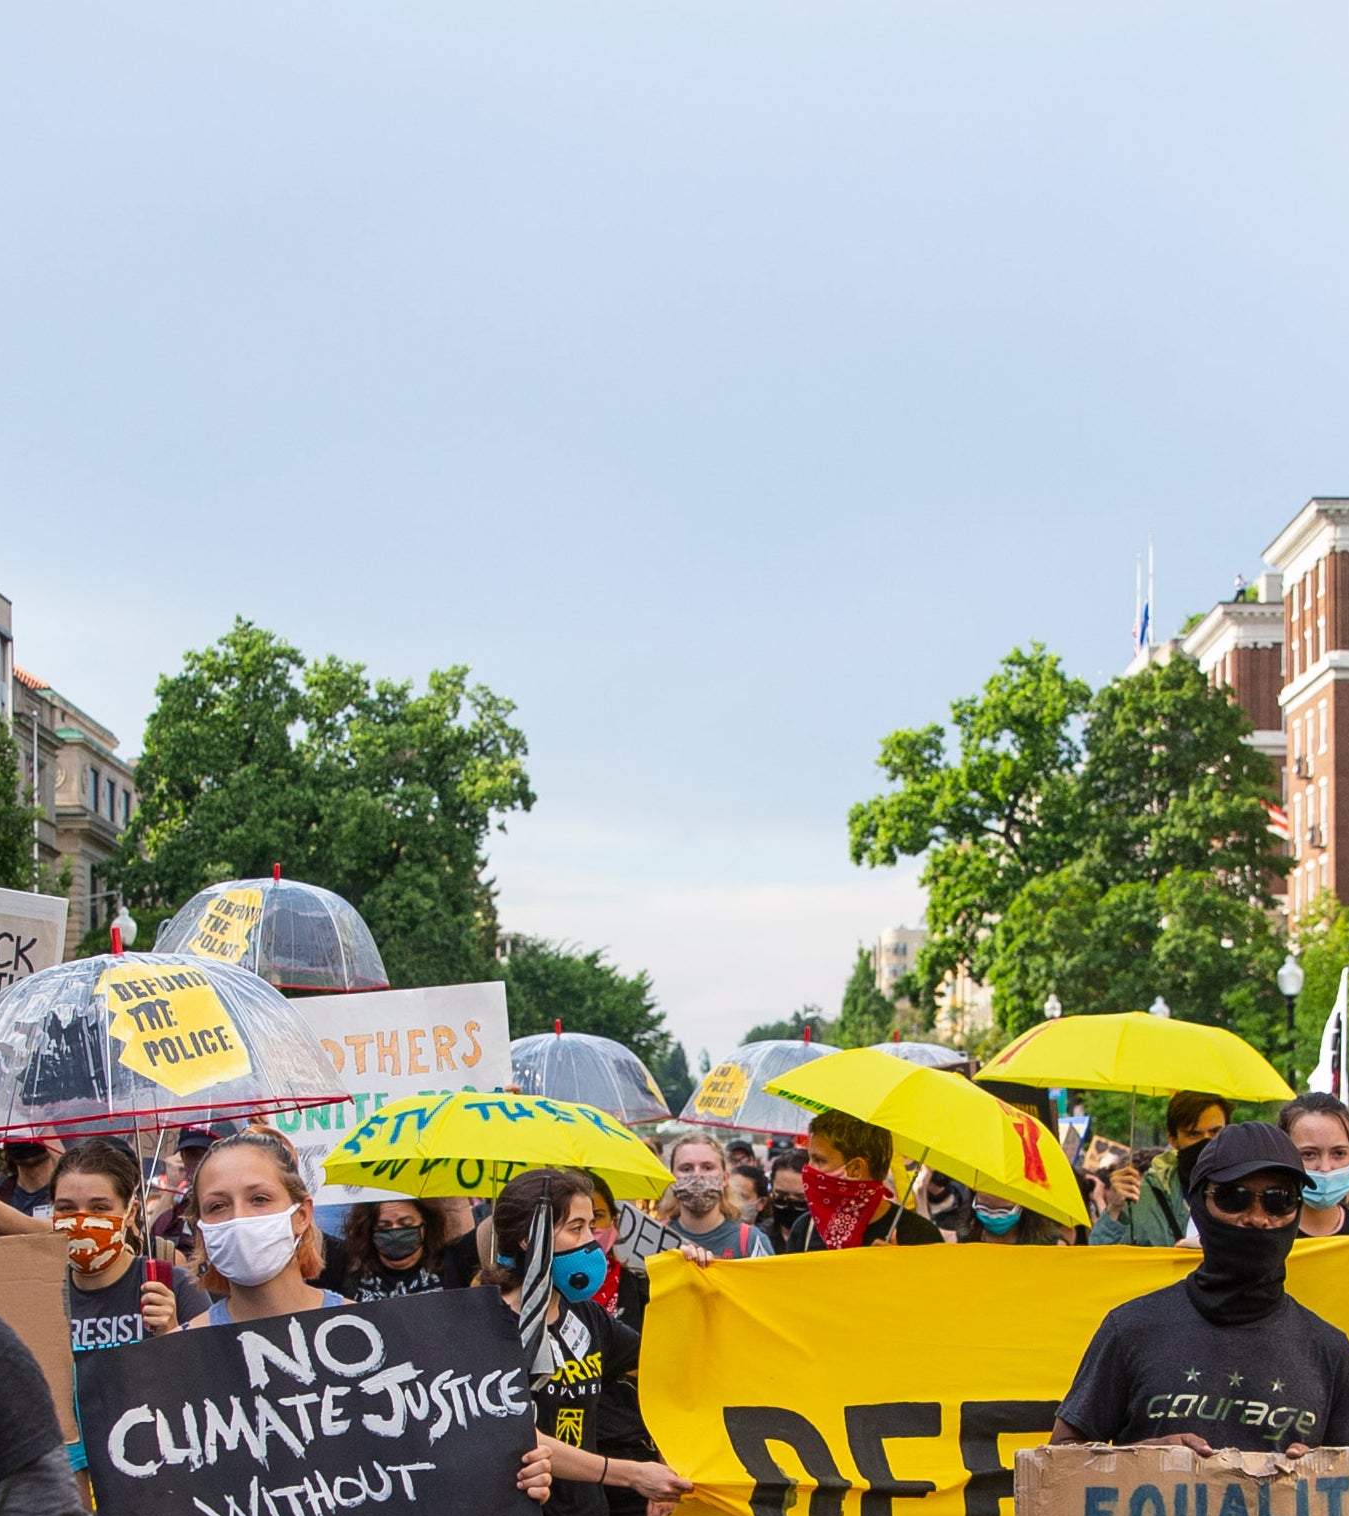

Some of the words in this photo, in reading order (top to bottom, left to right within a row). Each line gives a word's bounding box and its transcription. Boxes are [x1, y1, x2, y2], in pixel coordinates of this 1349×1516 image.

[203, 913, 231, 936] THE
[111, 970, 208, 1002] DEFUND
[127, 998, 178, 1033] THE
[142, 1026, 233, 1067] POLICE
[71, 1312, 143, 1347] RESIST
[237, 1314, 387, 1391] NO
[107, 1384, 353, 1479] CLIMATE
[359, 1362, 529, 1446] JUSTICE
[1146, 1393, 1317, 1441] courage
